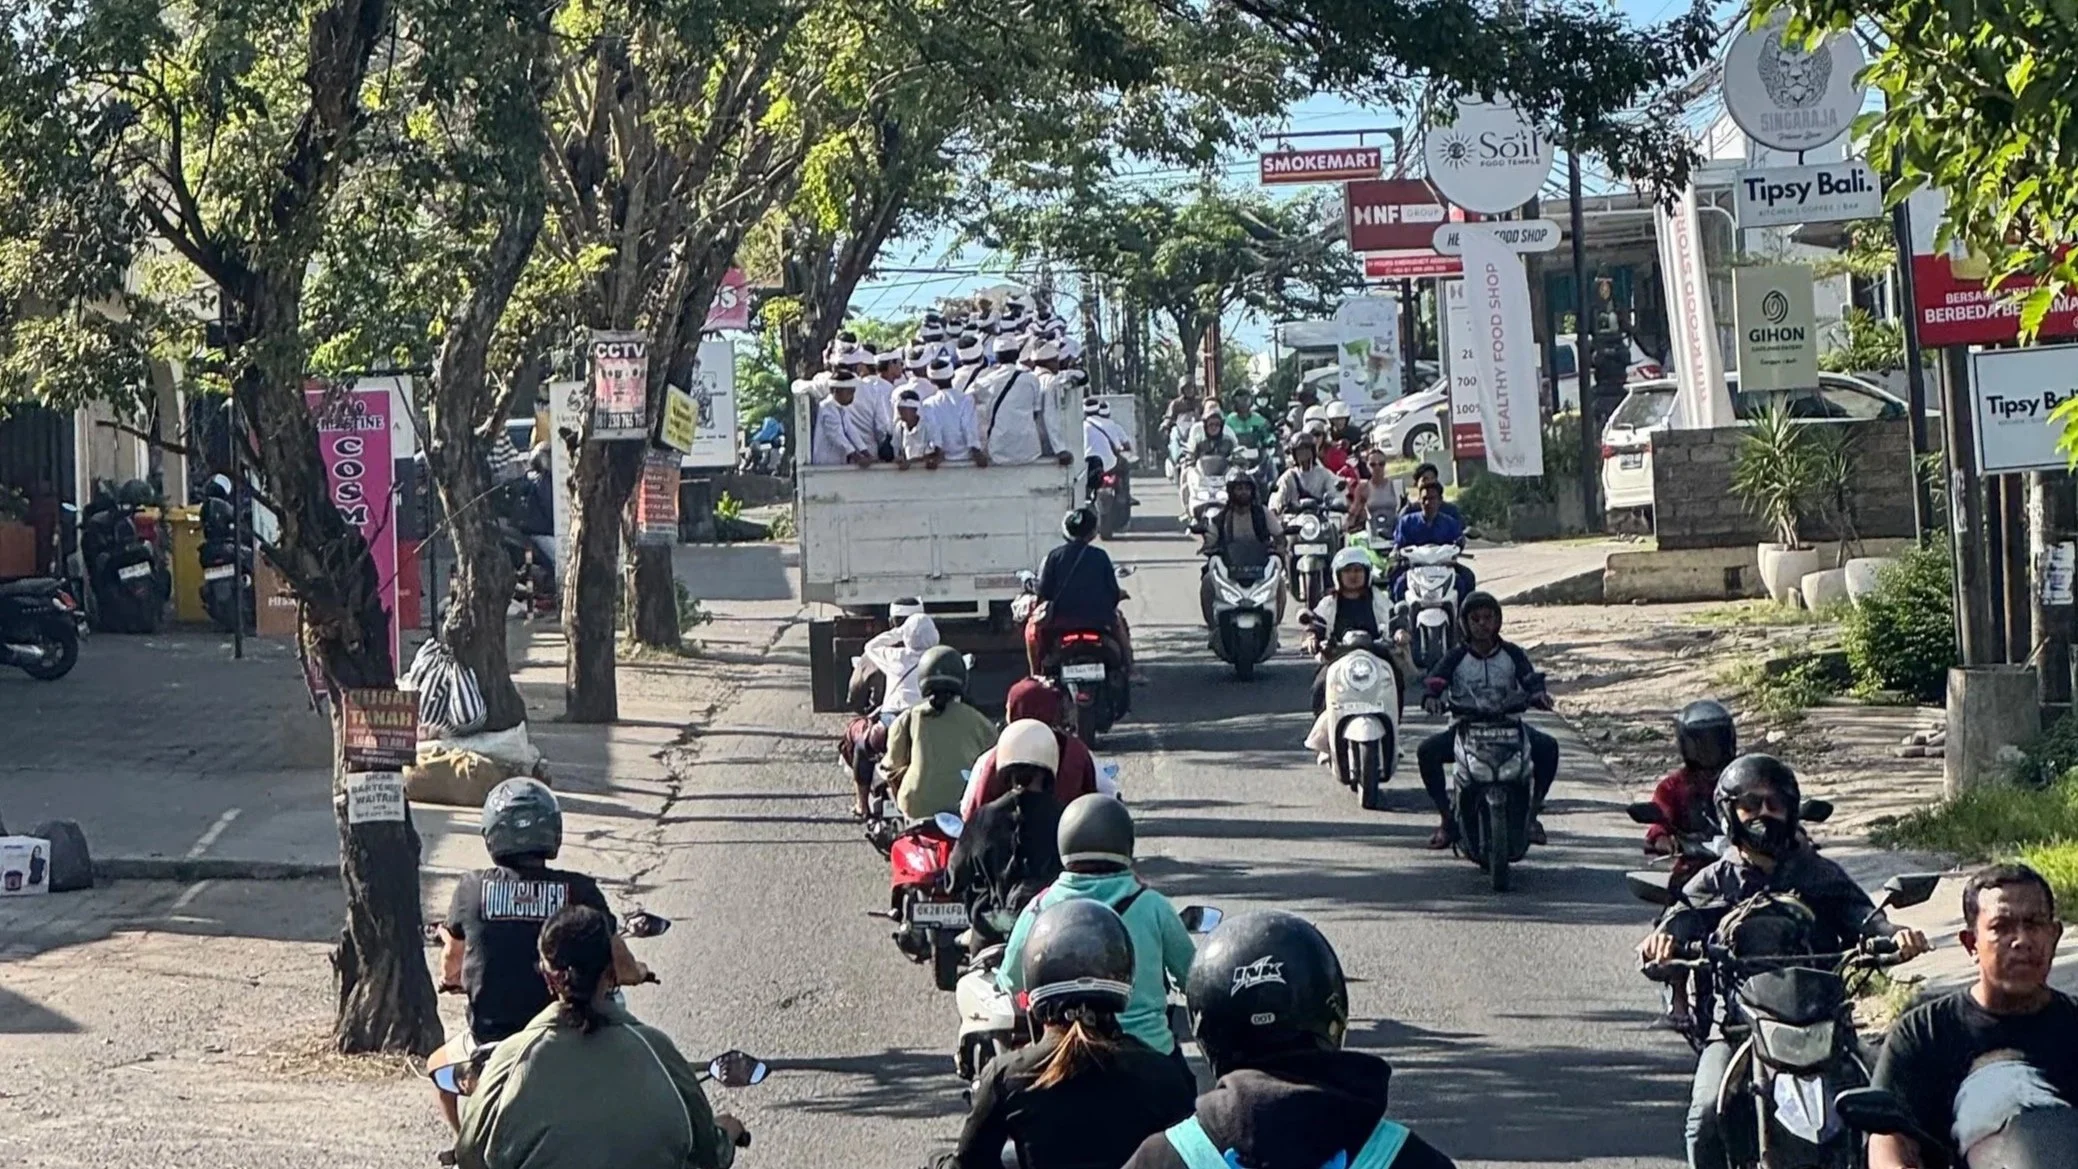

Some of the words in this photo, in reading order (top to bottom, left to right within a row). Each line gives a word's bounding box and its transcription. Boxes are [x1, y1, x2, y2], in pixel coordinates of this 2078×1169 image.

[1760, 108, 1837, 132] SINGARAJA
[1263, 152, 1378, 172] SMOKEMART
[1508, 158, 1540, 166] TEMPLE
[1743, 177, 1812, 207] Tipsy
[1817, 168, 1873, 196] Bali.
[1406, 208, 1440, 217] GROUP
[1494, 228, 1519, 245] OOD
[1521, 228, 1548, 243] SHOP
[1486, 262, 1502, 311] SHOP
[1684, 281, 1700, 344] FOOD
[1924, 302, 1998, 324] BERBEDA
[1490, 313, 1506, 362] FOOD
[1749, 326, 1804, 342] GIHON
[596, 342, 645, 358] CCTV
[1494, 366, 1512, 443] HEALTHY
[1986, 395, 2040, 419] Tipsy
[349, 709, 413, 727] TANAH
[486, 880, 565, 920] QUIKSILVER
[1231, 955, 1287, 997] INK
